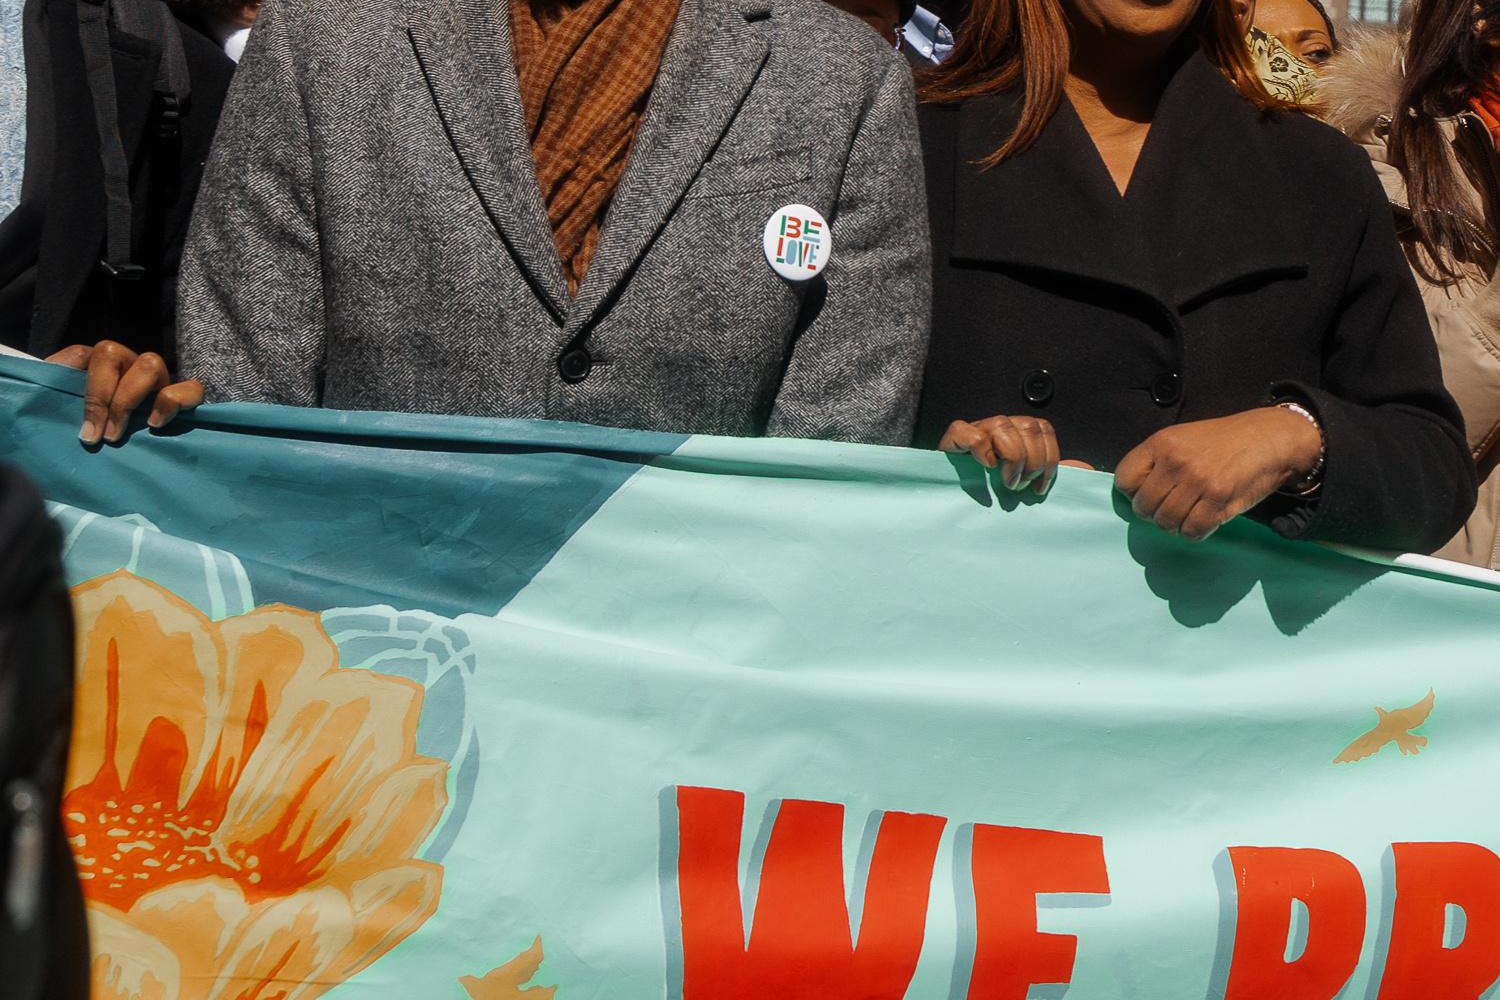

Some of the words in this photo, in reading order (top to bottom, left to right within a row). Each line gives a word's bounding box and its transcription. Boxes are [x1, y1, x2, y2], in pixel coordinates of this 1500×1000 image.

[780, 215, 822, 243] BE
[776, 237, 820, 271] LOVE
[657, 784, 1112, 1000] WE
